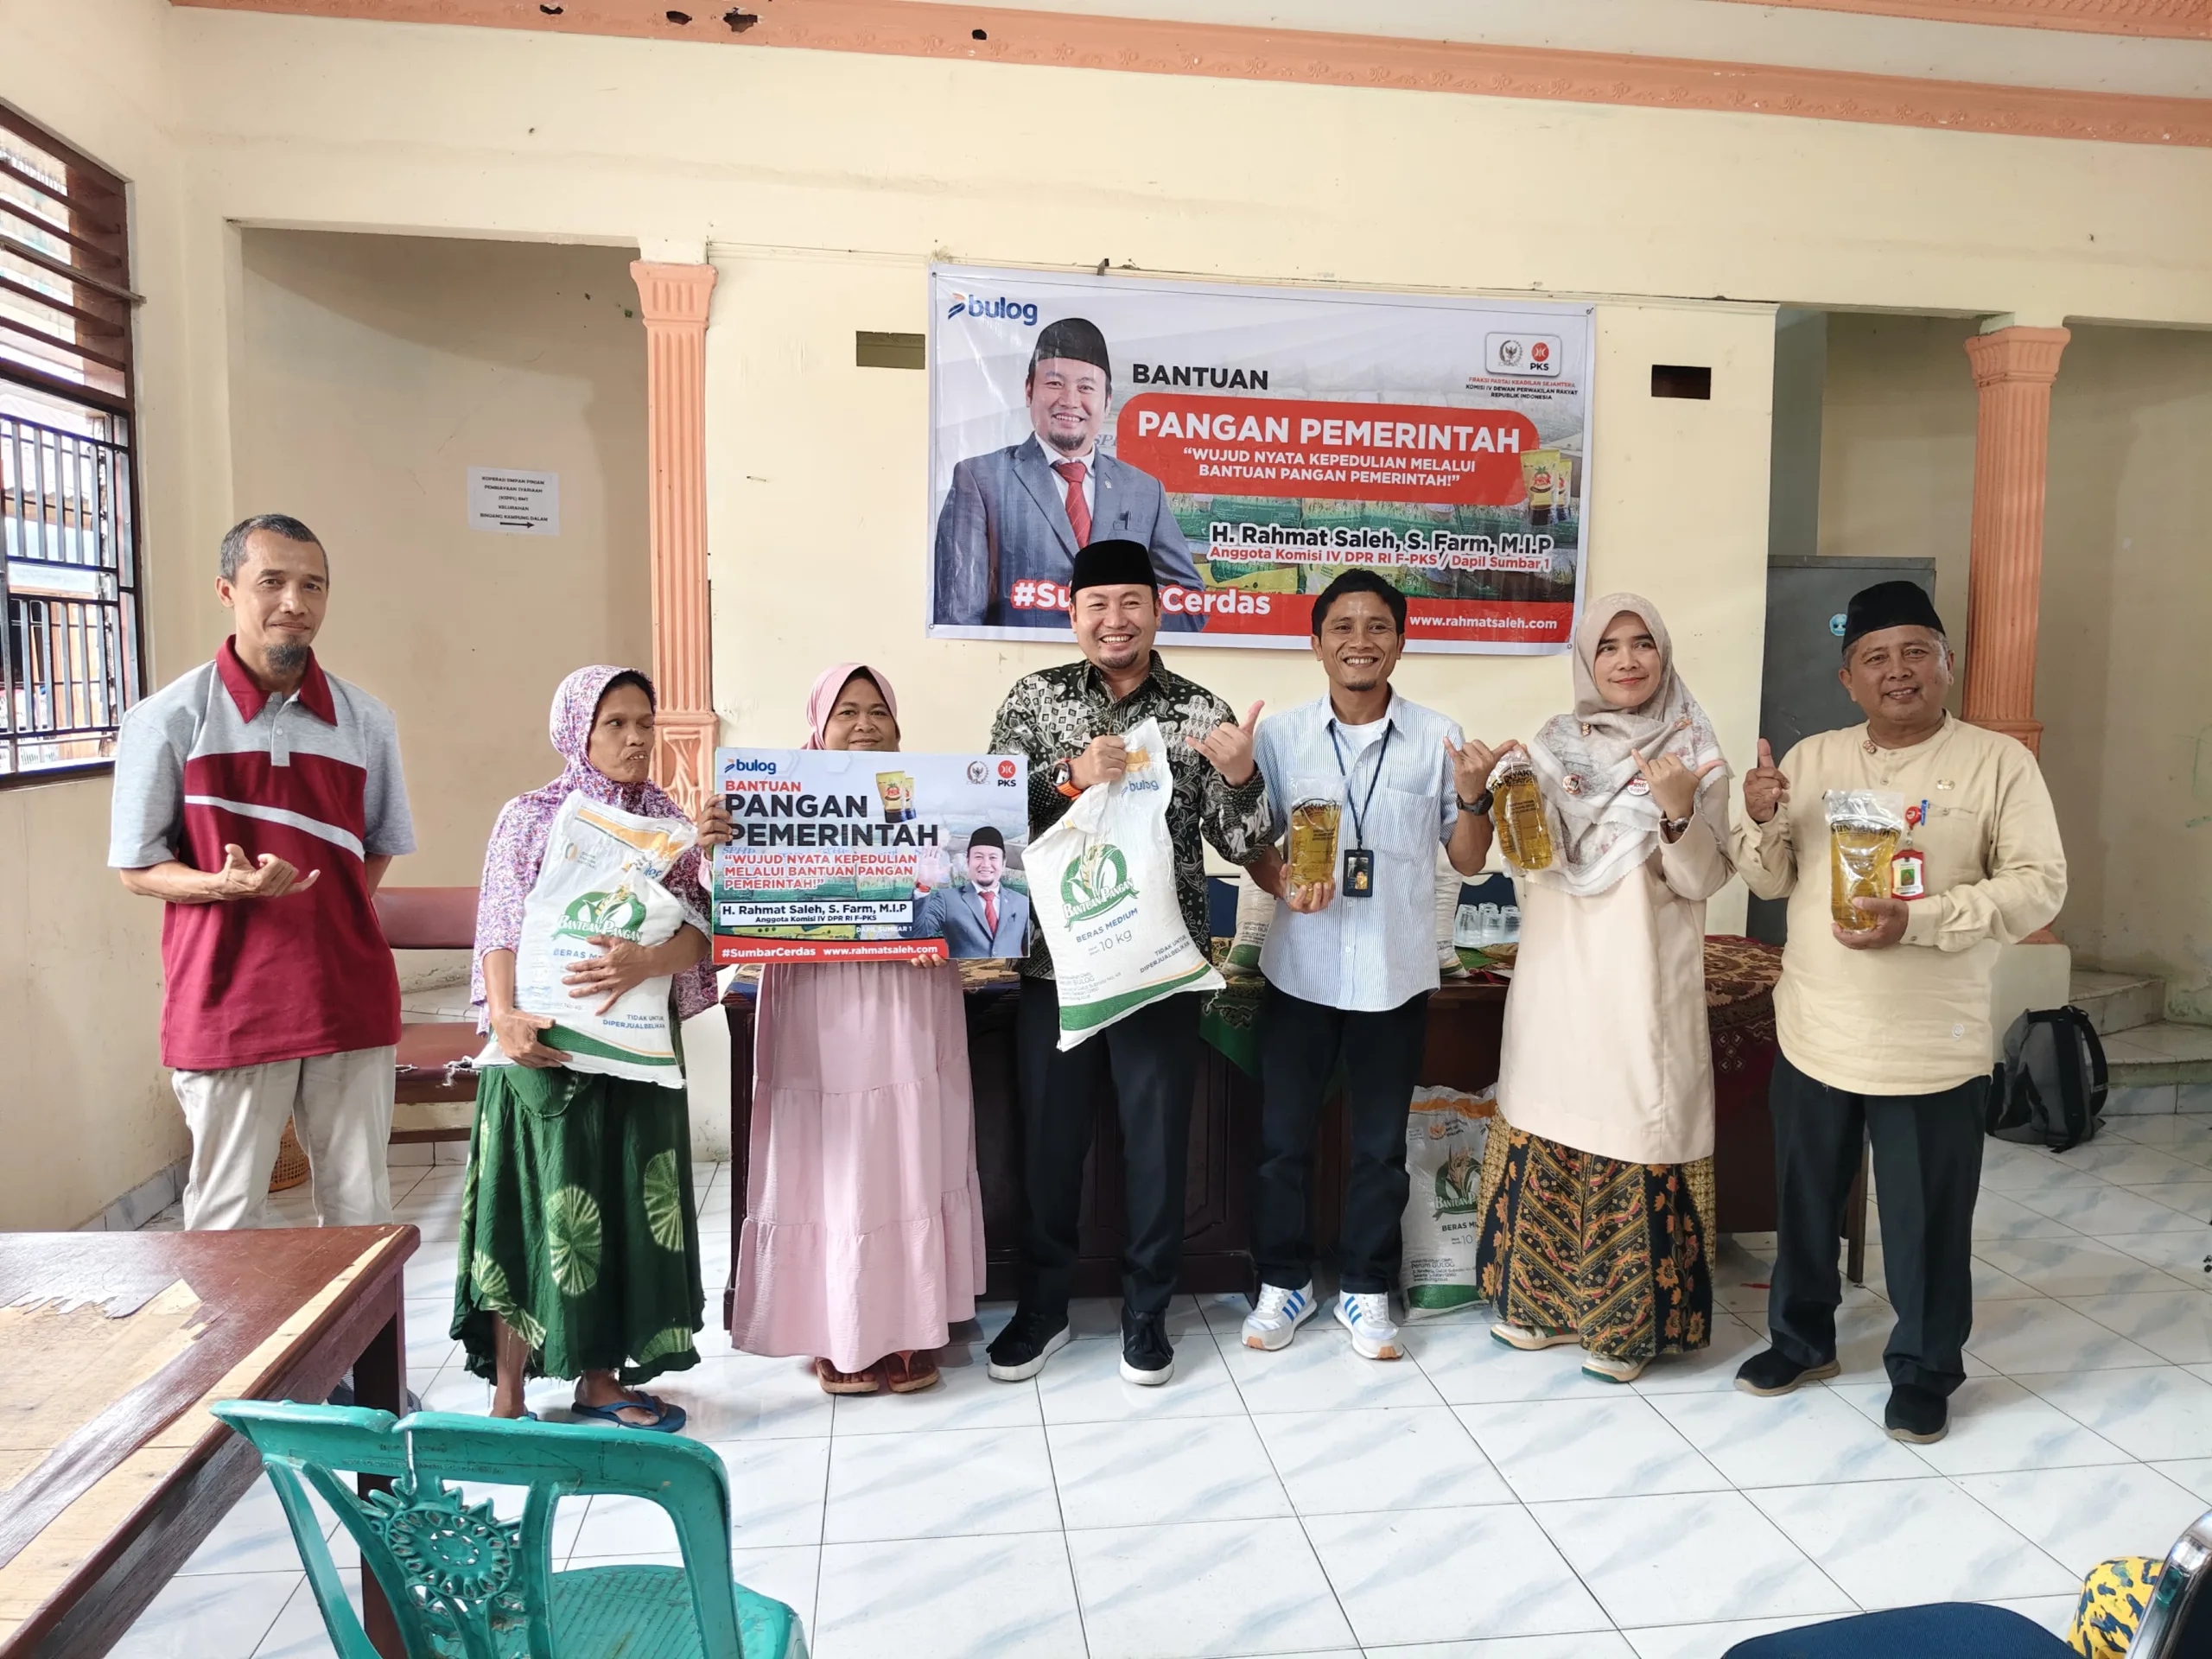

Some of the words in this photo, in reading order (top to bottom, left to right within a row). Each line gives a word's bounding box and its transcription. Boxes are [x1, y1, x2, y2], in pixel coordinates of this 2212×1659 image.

[969, 295, 1038, 326] bulog
[1133, 364, 1268, 390] BANTUAN
[1138, 410, 1288, 442] PANGAN
[1300, 418, 1520, 454] PEMERINTAH
[1255, 451, 1305, 465] NYATA
[1309, 454, 1406, 469] KEPEDULIAN
[1411, 458, 1475, 472] MELALUI
[1199, 465, 1276, 479] BANTUAN
[1281, 467, 1346, 482] PANGAN
[1212, 525, 1235, 543] H.
[1242, 524, 1328, 546] Rahmat
[1334, 529, 1401, 552] Saleh,
[1408, 532, 1427, 550] S.
[1435, 534, 1495, 555] Farm,
[1502, 536, 1551, 554] M.I.P
[1210, 546, 1271, 561] Anggota
[1275, 548, 1323, 562] Komisi
[1326, 550, 1341, 562] IV
[1344, 551, 1374, 563] DPR
[1378, 553, 1391, 563] RI
[1395, 554, 1437, 566] F-PKS
[1452, 556, 1486, 569] Dapil
[1490, 557, 1541, 569] Sumbar
[1543, 559, 1550, 569] 1
[1409, 616, 1558, 630] www.rahmatsaleh.com
[736, 759, 777, 775] bulog
[725, 780, 801, 792] BANTUAN
[1128, 779, 1160, 791] bulog
[726, 794, 868, 818] PANGAN
[726, 823, 938, 847] PEMERINTAH
[786, 854, 830, 864] NYATA
[835, 854, 918, 864] KEPEDULIAN
[724, 866, 785, 876] MELALUI
[788, 866, 855, 876] BANTUAN
[858, 866, 913, 875] PANGAN
[1063, 896, 1103, 919] BANTUAN
[1100, 877, 1135, 903] PANGAN
[722, 906, 734, 915] H.
[739, 905, 785, 914] Rahmat
[790, 905, 824, 916] Saleh,
[829, 905, 840, 914] S.
[843, 904, 876, 914] Farm,
[880, 904, 907, 913] M.I.P
[559, 914, 601, 934] BANTUAN
[601, 920, 644, 942] PANGAN
[1076, 925, 1104, 943] BERAS
[1105, 907, 1138, 930] MEDIUM
[1099, 938, 1114, 951] 10
[1116, 930, 1132, 944] kg
[1154, 944, 1172, 957] TIDAK
[1173, 934, 1188, 949] UNTUK
[553, 948, 586, 959] BERAS
[721, 947, 816, 958] #SumbarCerdas
[823, 945, 938, 956] www.rahmatsaleh.com
[602, 1019, 665, 1029] DIPERJUALBELIKAN
[1435, 1196, 1469, 1210] BANTUAN
[1442, 1222, 1467, 1231] BERAS
[1461, 1235, 1473, 1245] 10
